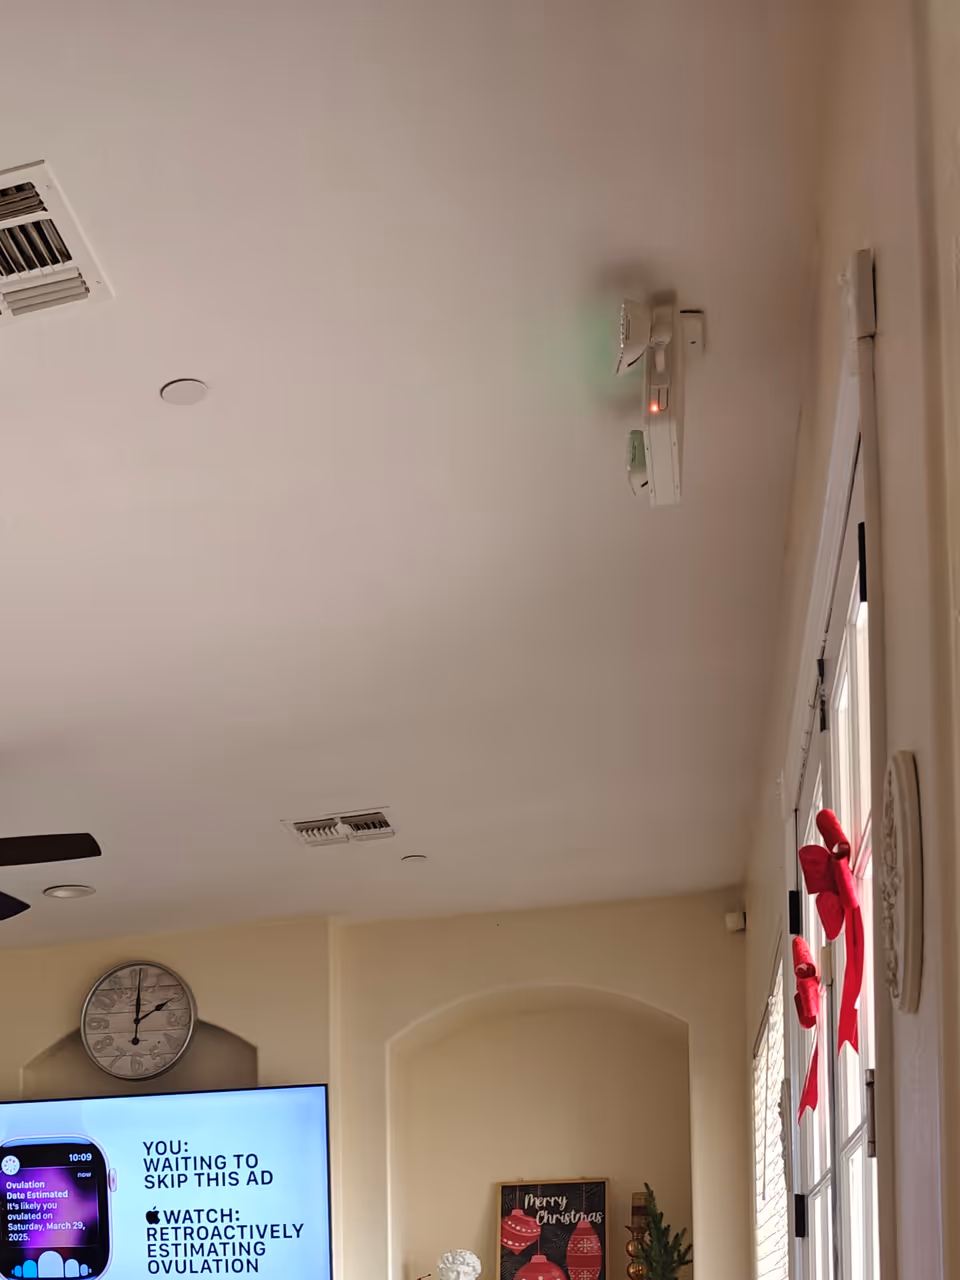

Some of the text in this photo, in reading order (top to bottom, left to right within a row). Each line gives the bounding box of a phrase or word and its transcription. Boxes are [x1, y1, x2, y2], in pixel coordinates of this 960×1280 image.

[143, 1140, 189, 1156] YOU:
[69, 1153, 92, 1162] 10:09
[143, 1153, 259, 1172] WAITING TO
[6, 1180, 45, 1189] Ovulation
[144, 1170, 274, 1189] SKIP THIS AD
[6, 1190, 69, 1200] Date Estimated
[524, 1193, 568, 1210] Merry
[7, 1201, 58, 1211] It's likely you
[7, 1212, 53, 1221] ovulated on
[163, 1208, 240, 1224] WATCH:
[536, 1209, 604, 1225] Christmas
[7, 1221, 86, 1232] Saturday, March 29,
[146, 1223, 304, 1242] RETROACTIVELY
[8, 1233, 31, 1242] 2025.
[147, 1241, 266, 1258] ESTIMATING
[147, 1258, 259, 1275] OVULATION
